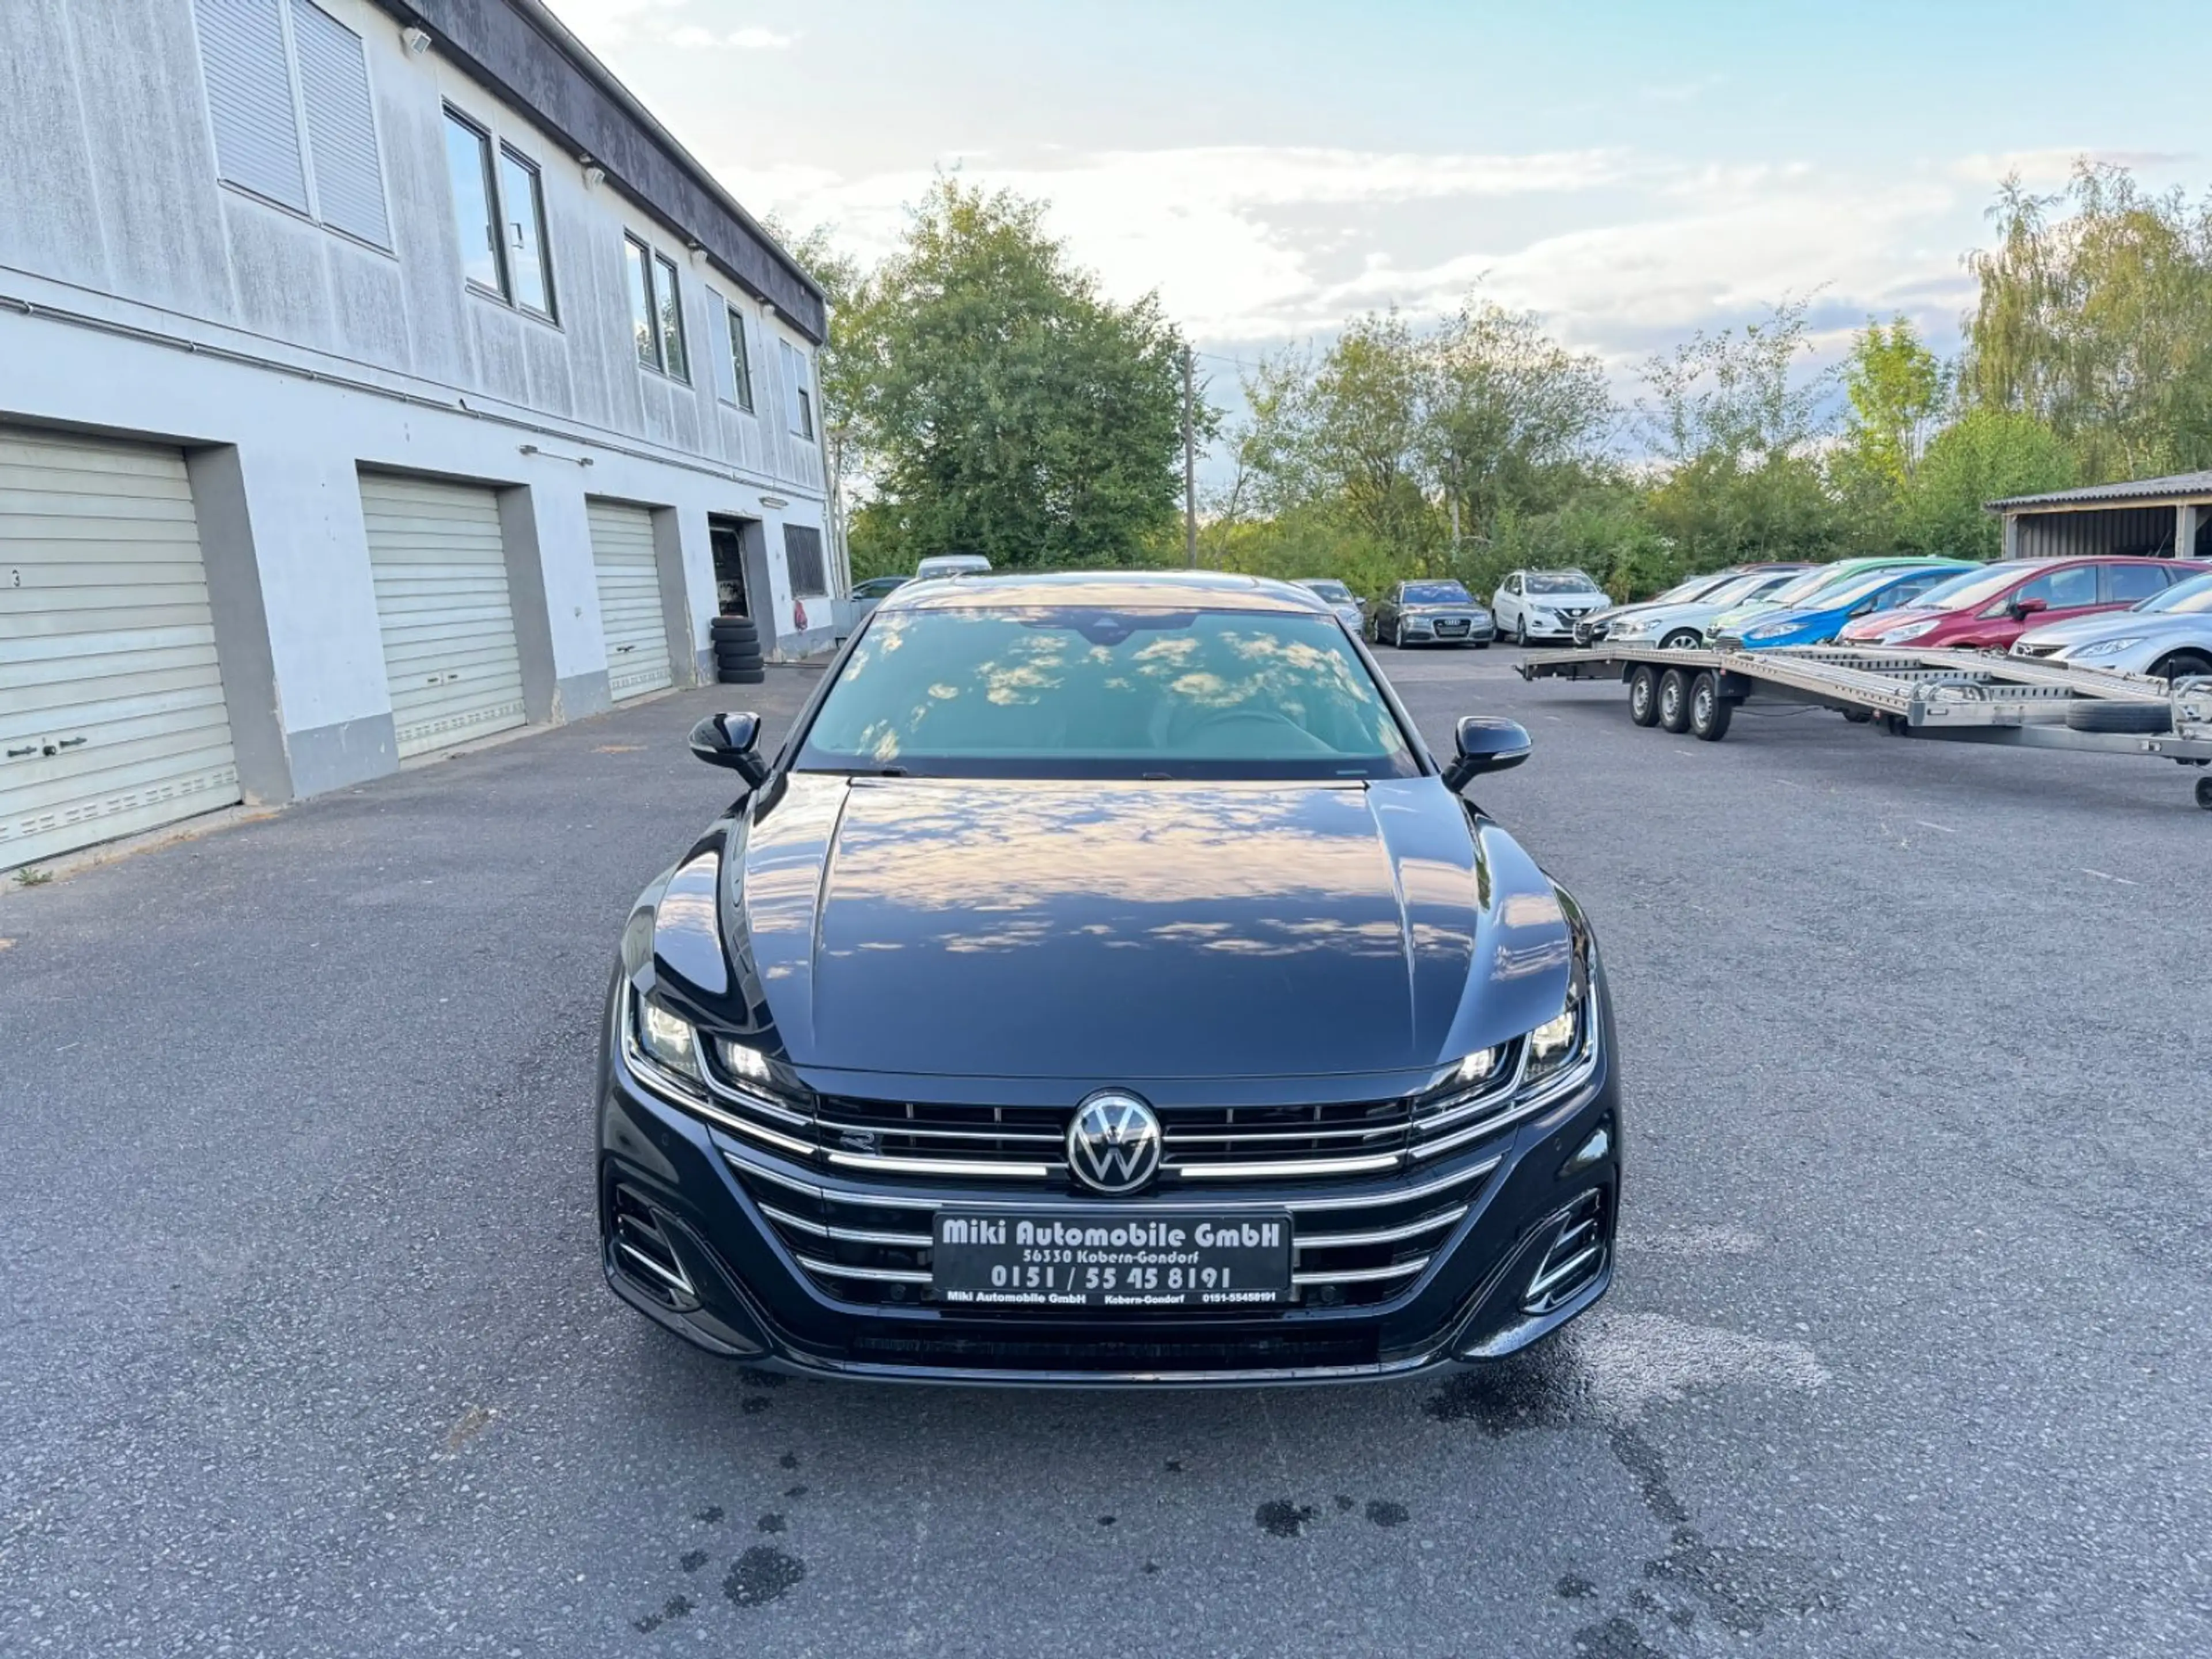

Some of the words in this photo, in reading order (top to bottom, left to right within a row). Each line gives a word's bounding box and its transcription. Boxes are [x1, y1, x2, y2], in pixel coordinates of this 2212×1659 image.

[943, 1219, 1006, 1244] Miki
[1016, 1221, 1185, 1247] Automobile
[1194, 1222, 1279, 1247] GmbH
[1023, 1249, 1071, 1263] 56330
[1077, 1250, 1199, 1264] Kobern-Gondorf
[991, 1265, 1054, 1287] 0151
[1067, 1267, 1075, 1291] /
[1085, 1267, 1116, 1289] 55
[1127, 1267, 1158, 1289] 45
[1168, 1267, 1230, 1289] 8191
[947, 1291, 973, 1301] Miki
[976, 1292, 1046, 1303] Automobile
[1048, 1293, 1086, 1304] GmbH
[1104, 1294, 1184, 1305] Kobern-Gondorf
